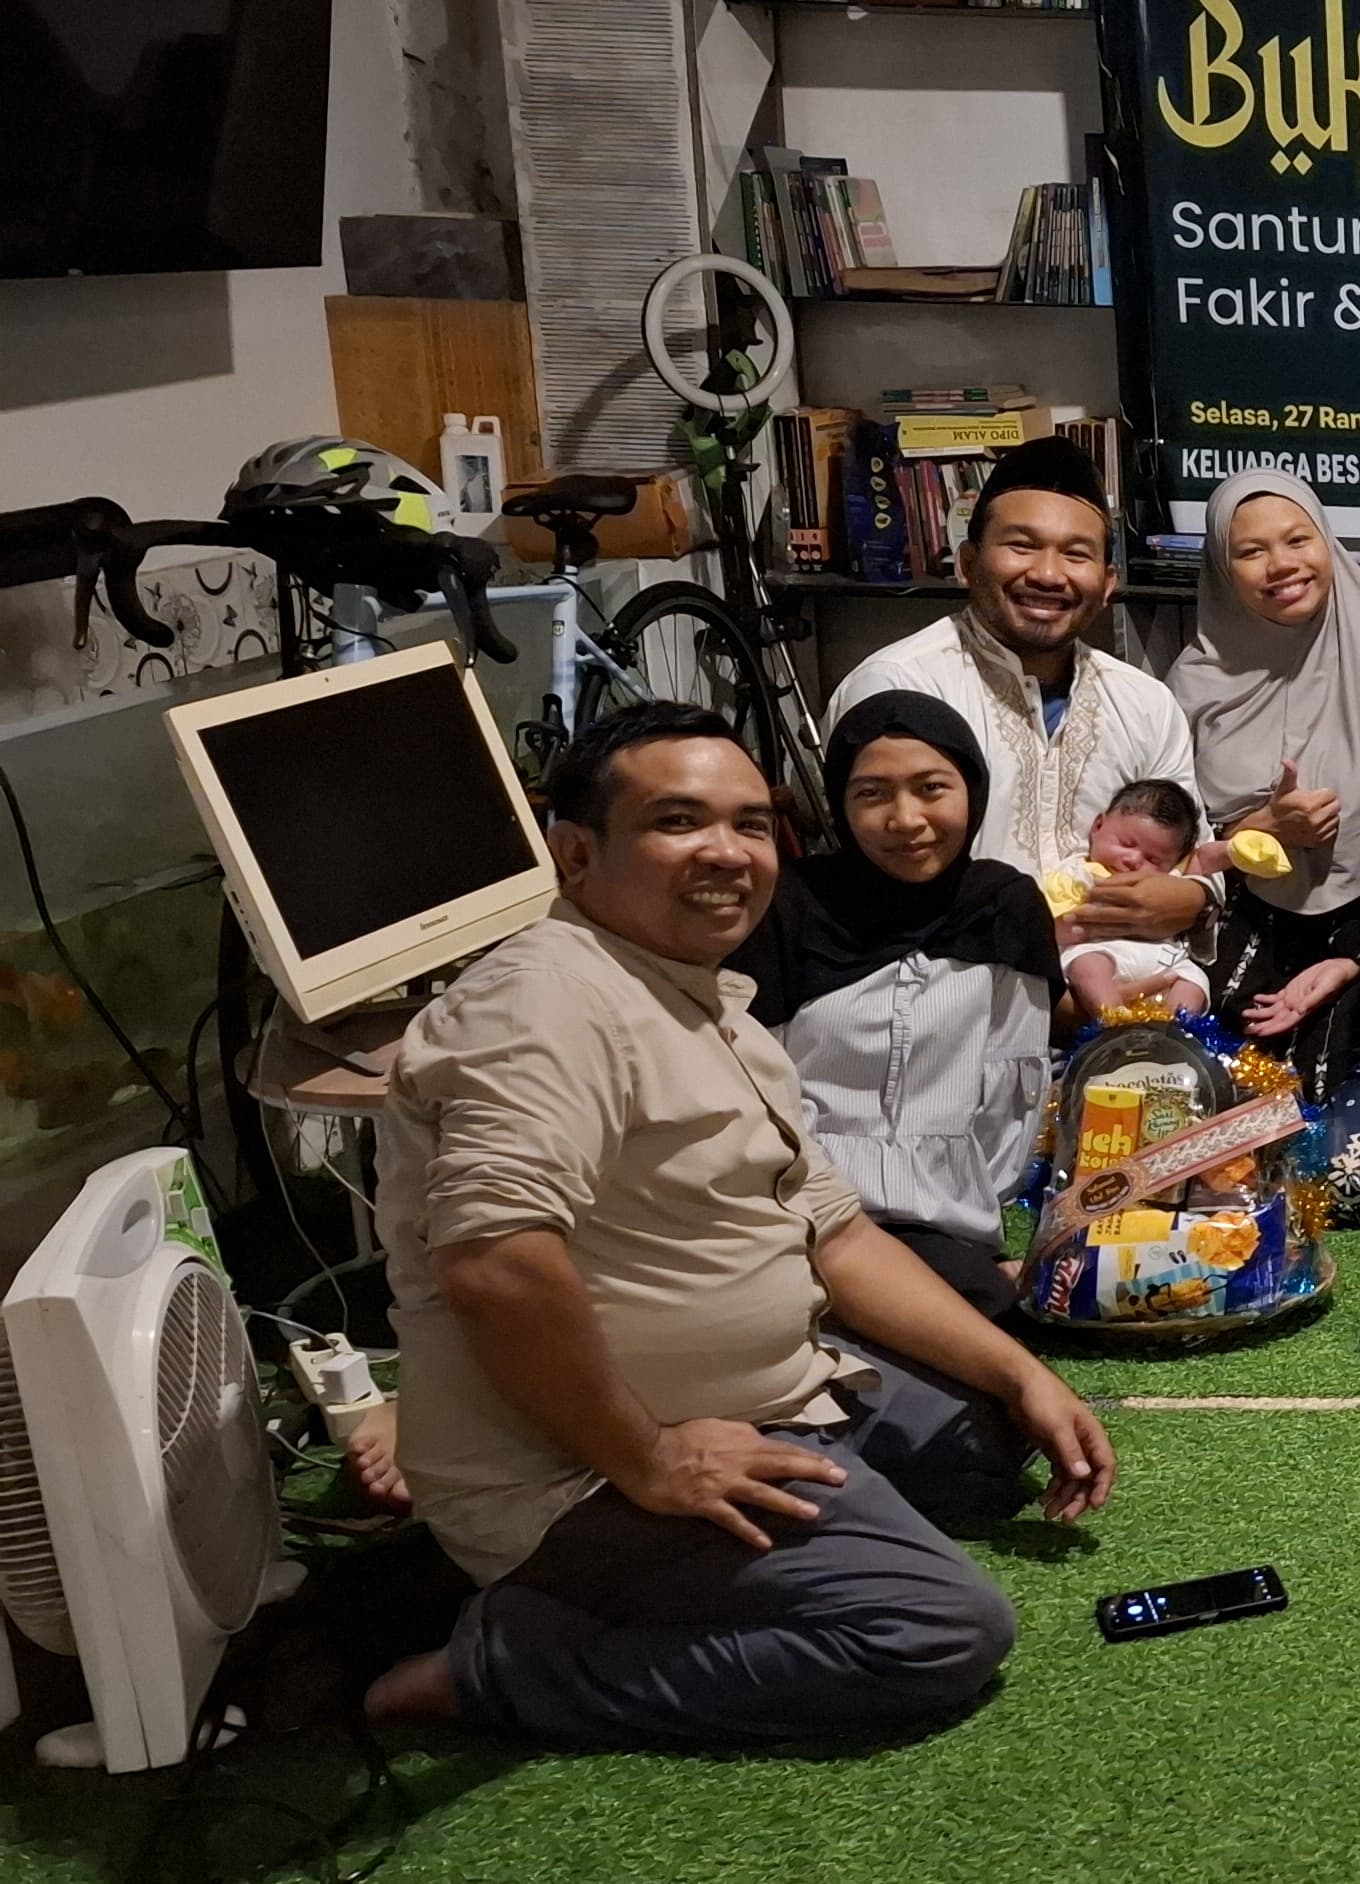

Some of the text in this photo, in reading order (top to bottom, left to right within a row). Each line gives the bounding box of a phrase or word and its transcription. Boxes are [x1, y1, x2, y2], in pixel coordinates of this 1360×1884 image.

[1177, 276, 1313, 329] Fakir
[1191, 401, 1280, 431] Selasa,
[1284, 405, 1313, 428] 27
[953, 430, 987, 441] ALAM
[1082, 1124, 1132, 1155] teh
